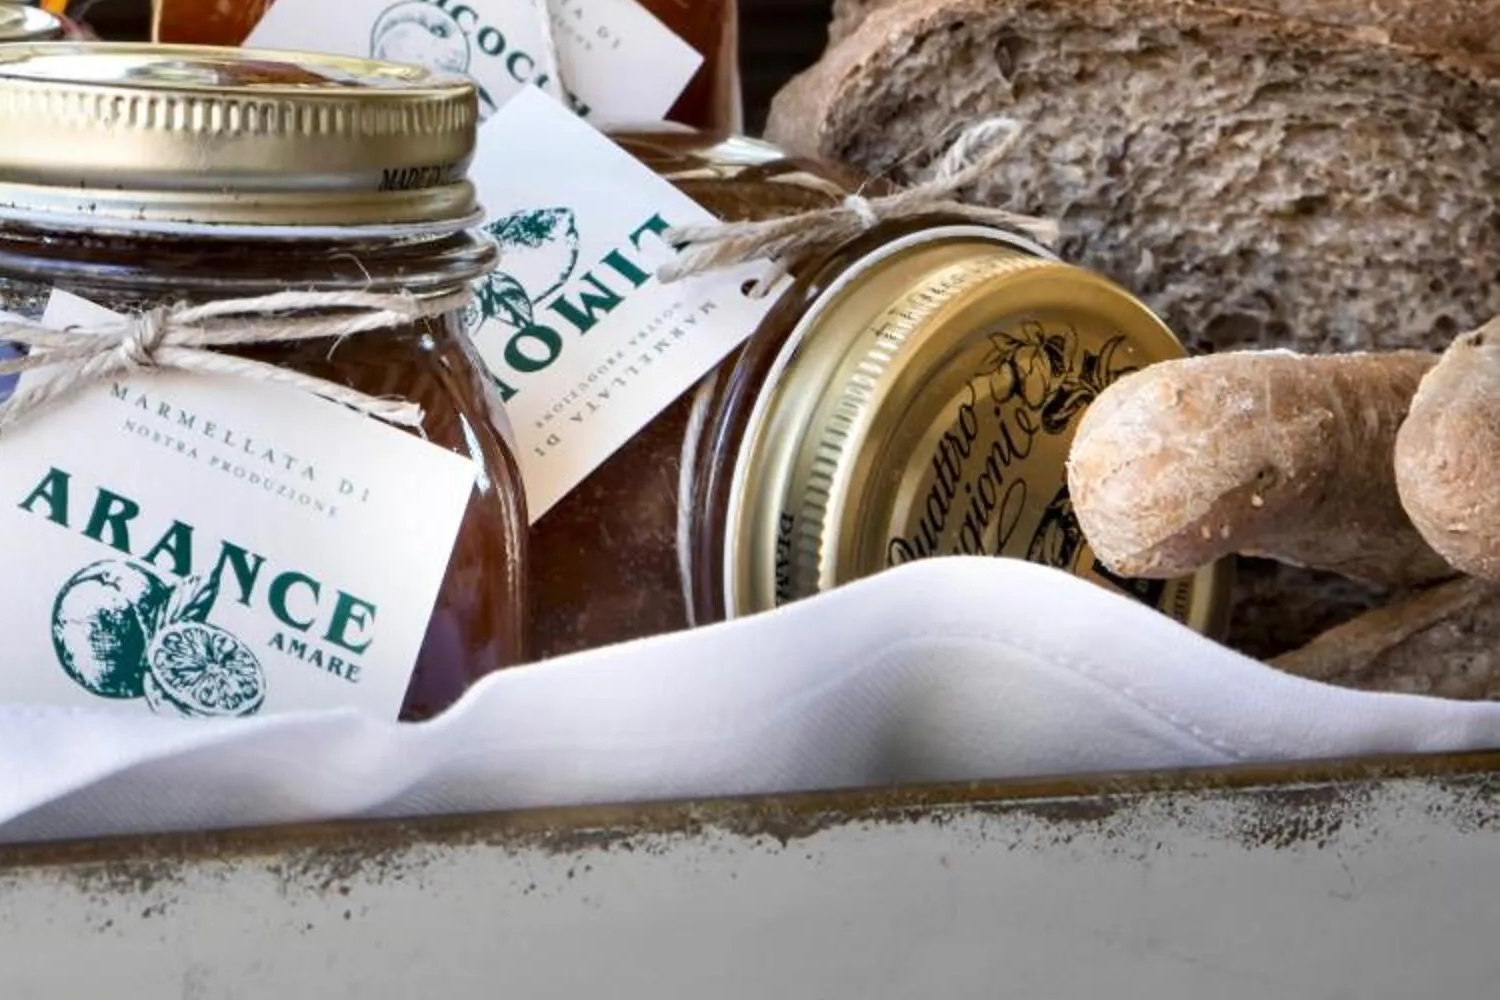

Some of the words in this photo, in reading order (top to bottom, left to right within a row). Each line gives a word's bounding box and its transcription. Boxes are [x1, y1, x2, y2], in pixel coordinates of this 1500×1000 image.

[569, 300, 718, 425] MARMELLATA
[110, 382, 315, 481] MARMELLATA
[338, 478, 371, 503] DI
[122, 419, 198, 460] NOSTRA
[208, 455, 338, 518] PRODUZIONE
[534, 433, 562, 458] DI
[18, 466, 377, 656] ARANCE
[267, 632, 363, 684] AMARE
